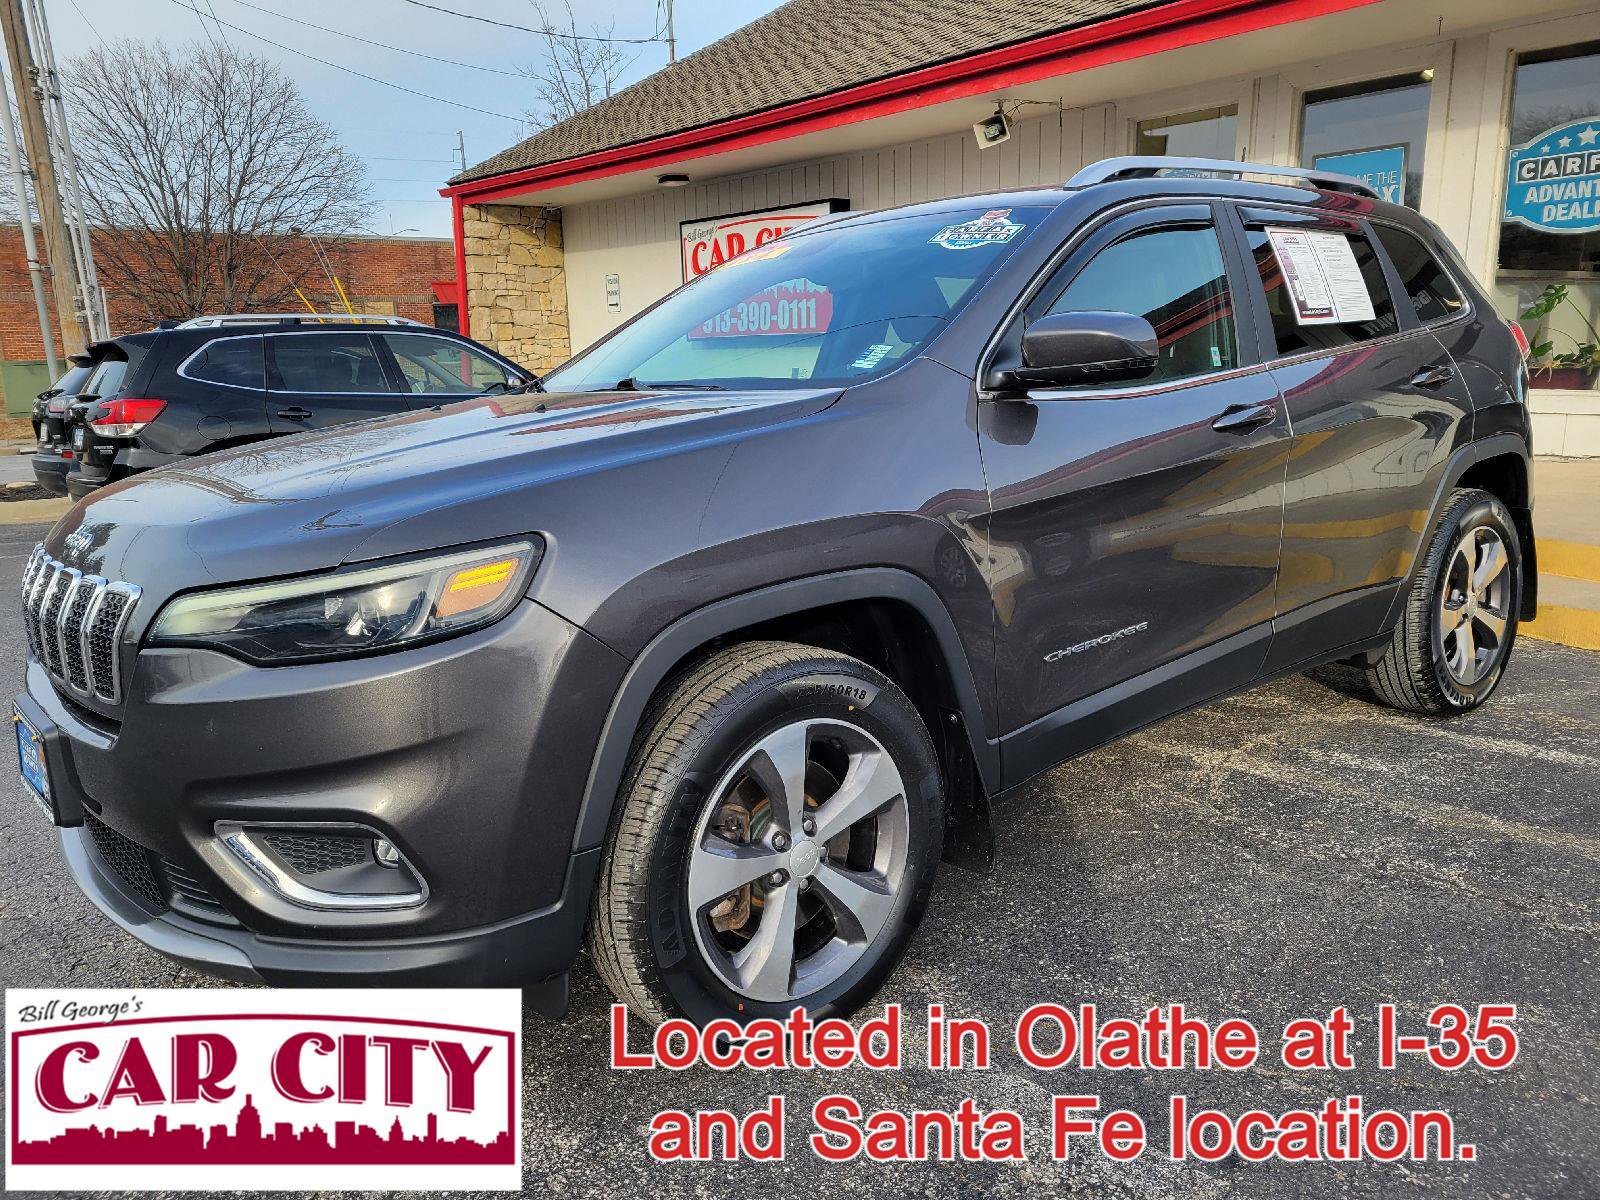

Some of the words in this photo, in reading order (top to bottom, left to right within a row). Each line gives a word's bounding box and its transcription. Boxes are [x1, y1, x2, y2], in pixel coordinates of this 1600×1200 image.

[1376, 171, 1398, 185] THE
[1543, 200, 1600, 223] DEAL
[1043, 621, 1148, 662] CHEROKEE
